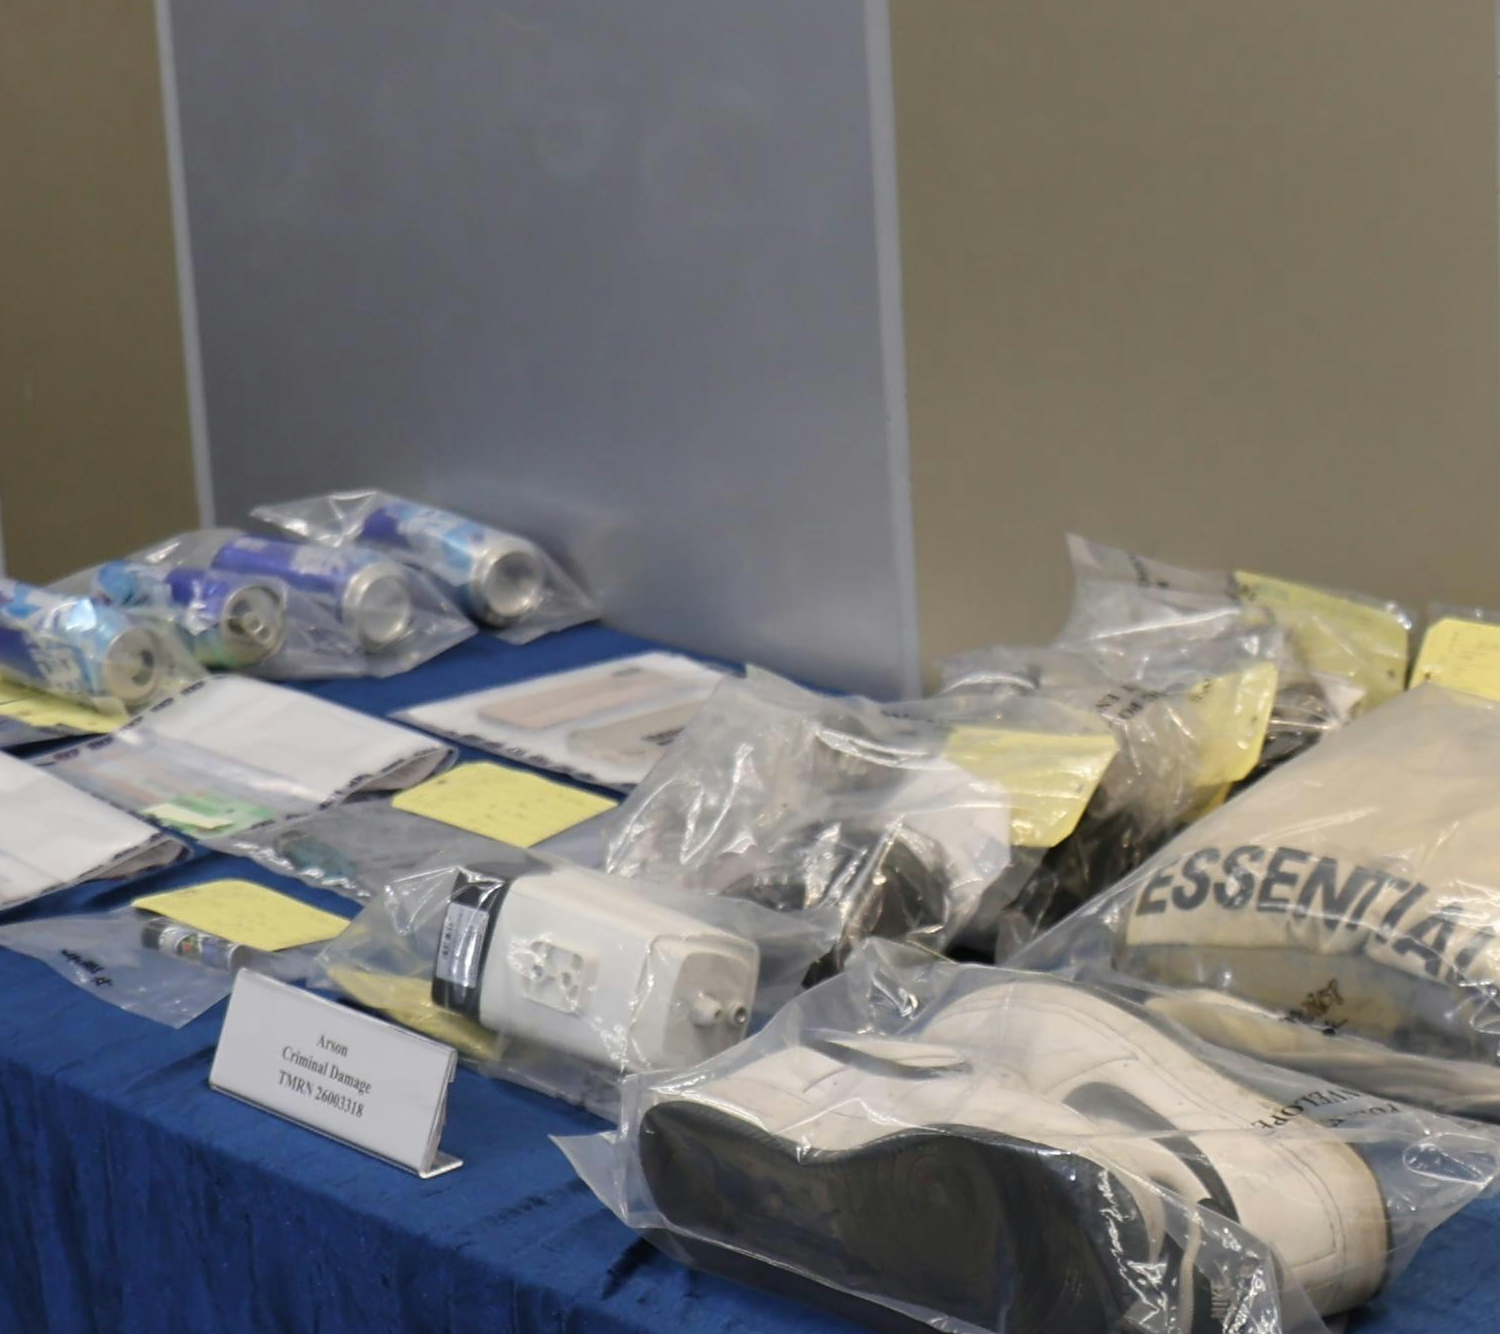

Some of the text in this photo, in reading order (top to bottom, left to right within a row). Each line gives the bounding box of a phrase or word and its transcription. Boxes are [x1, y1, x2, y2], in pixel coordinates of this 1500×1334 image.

[316, 1035, 348, 1057] Arson
[279, 1069, 314, 1097] TMRN
[282, 1046, 372, 1096] Criminal Damage
